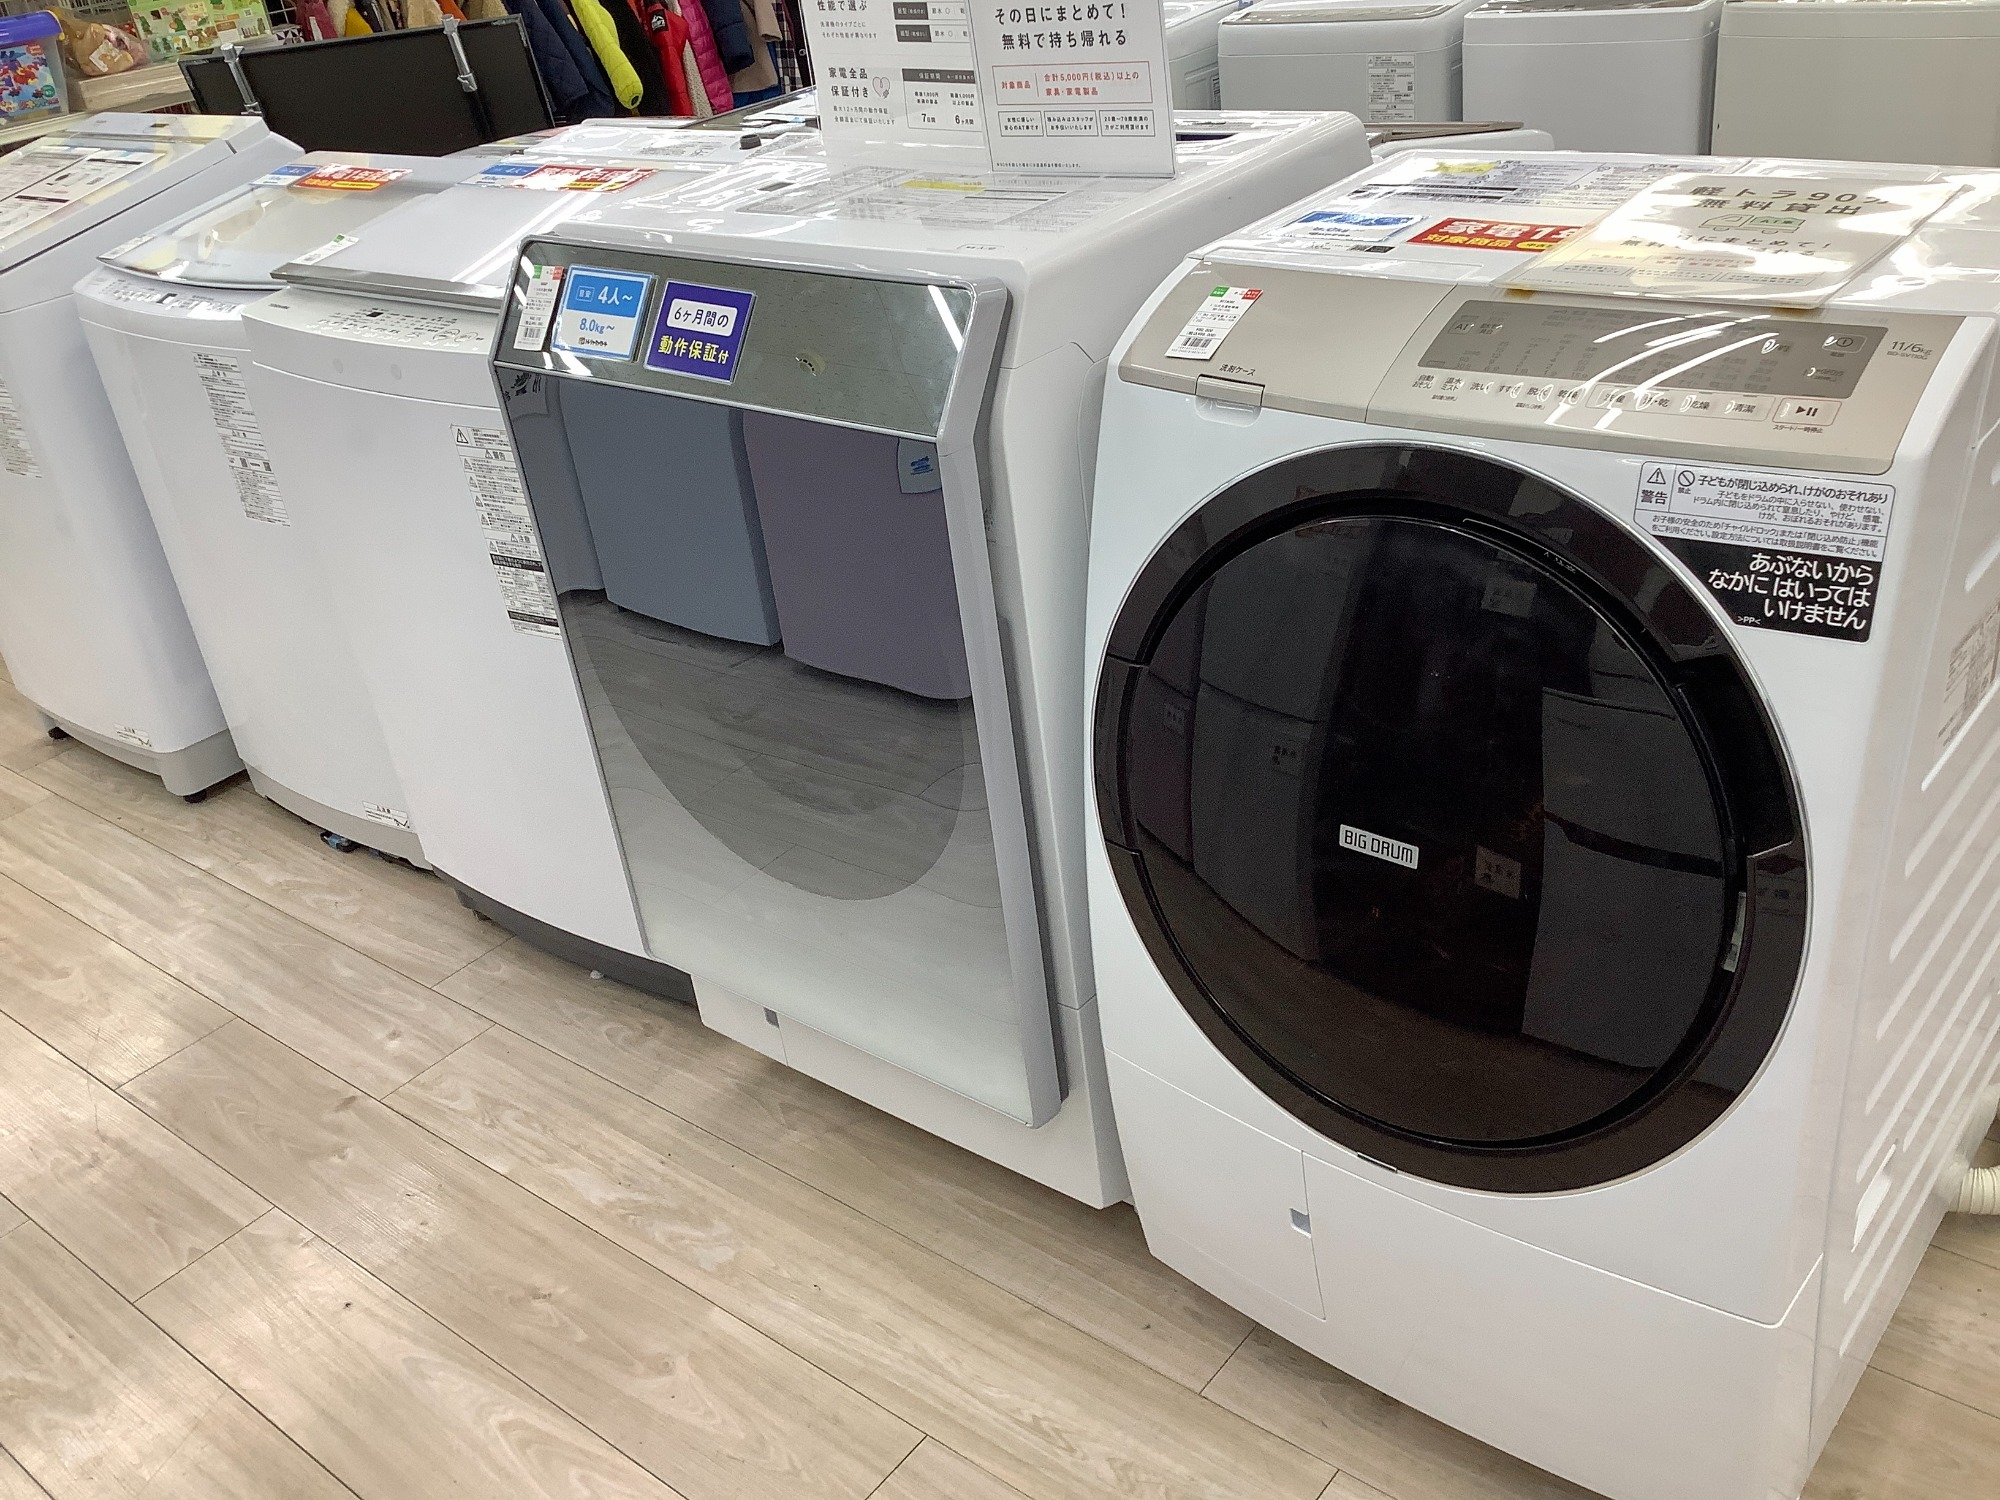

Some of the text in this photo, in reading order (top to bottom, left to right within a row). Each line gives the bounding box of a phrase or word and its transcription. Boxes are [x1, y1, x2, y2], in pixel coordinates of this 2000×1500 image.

[994, 3, 1127, 26] その日にまとめて！
[1001, 29, 1127, 51] 無料で持ち帰れる
[828, 67, 868, 80] 家電全品
[1044, 71, 1139, 83] 合計5,000円(税込)以上の
[830, 86, 870, 99] 保証付き
[1001, 80, 1031, 90] 対象商品
[658, 334, 730, 365] 動作保証付
[1219, 363, 1257, 377] 洗剤ケース
[1640, 488, 1668, 505] 警告
[1677, 486, 1691, 495] 禁止
[1697, 474, 1889, 504] 子どもが閉じ込められ、けがのおそれあり
[1749, 552, 1874, 584] あぶないから
[1737, 615, 1761, 625] >PP<
[1764, 597, 1867, 630] いけません
[1344, 829, 1414, 864] BIG DRUM
